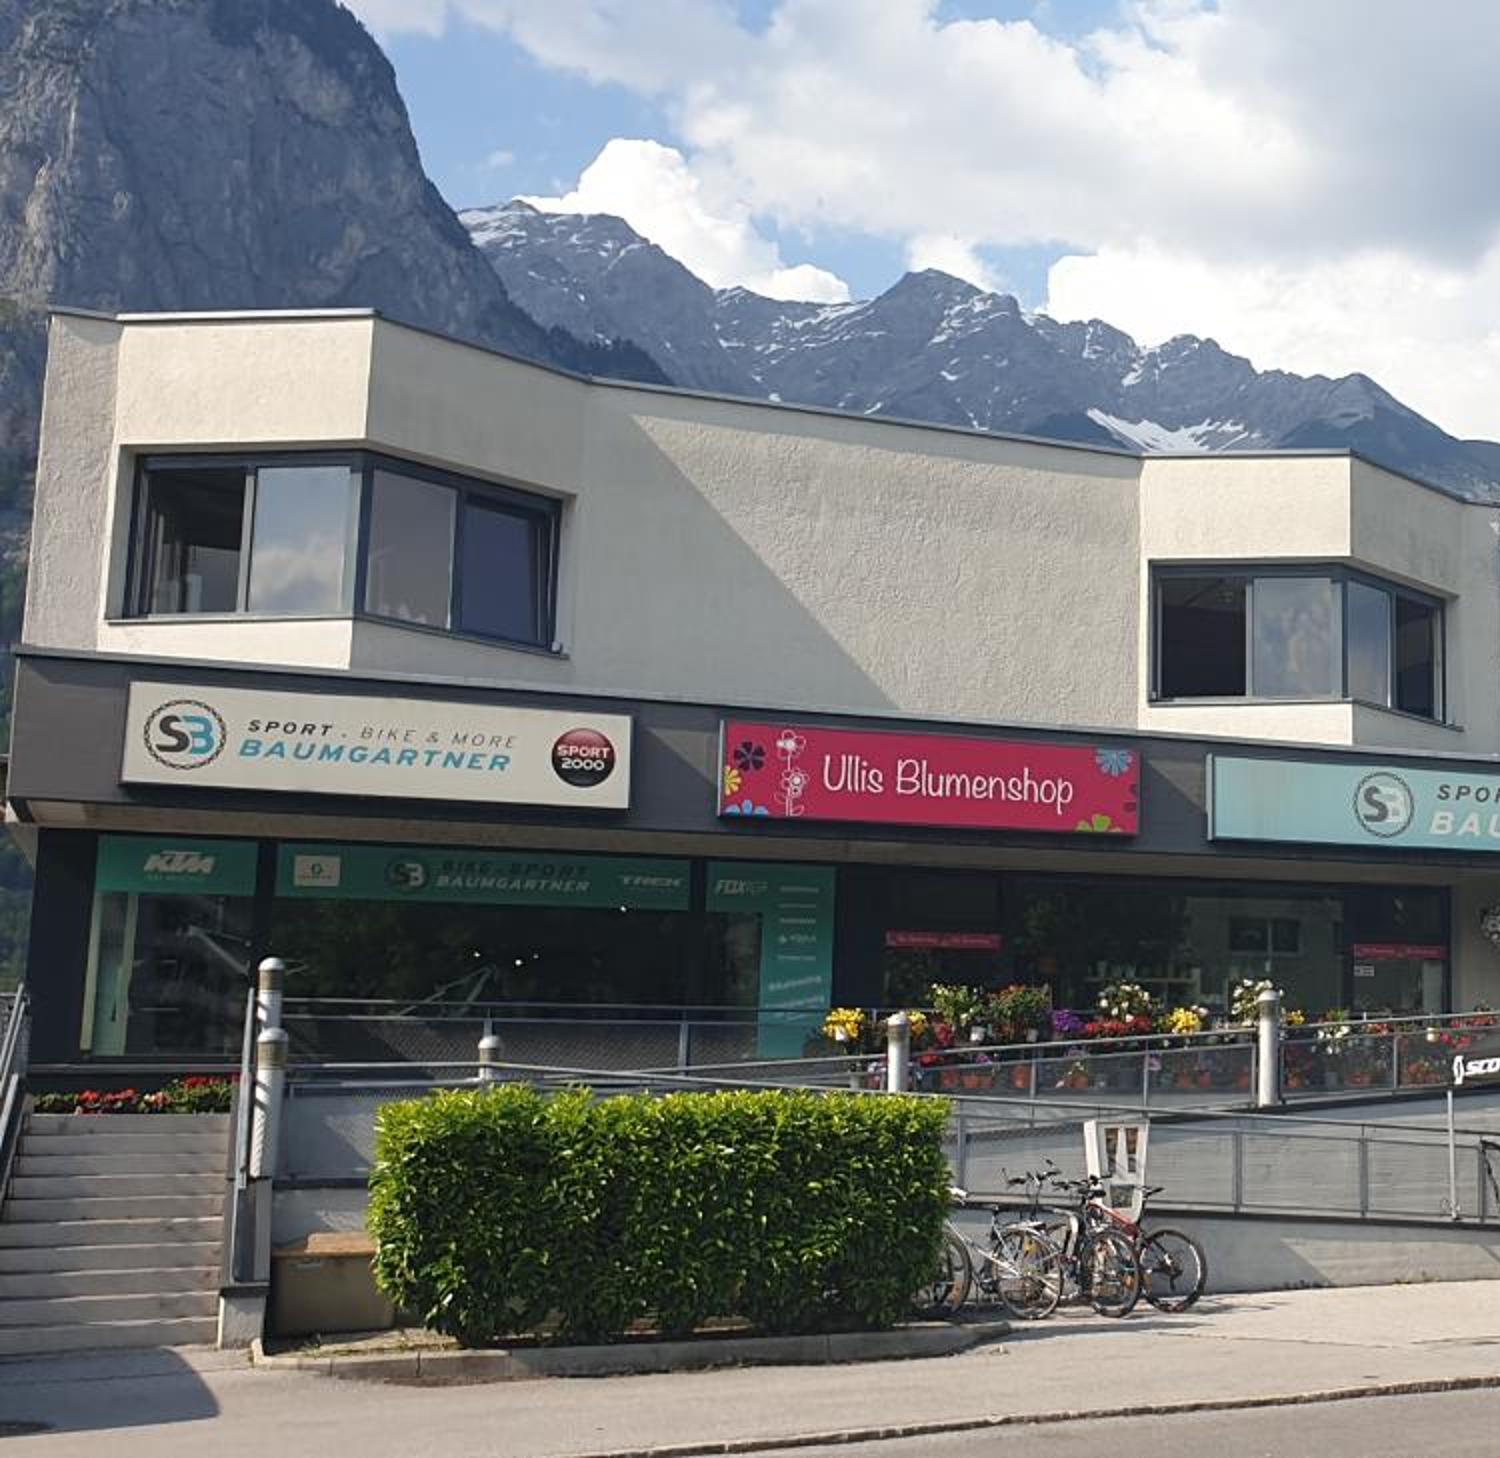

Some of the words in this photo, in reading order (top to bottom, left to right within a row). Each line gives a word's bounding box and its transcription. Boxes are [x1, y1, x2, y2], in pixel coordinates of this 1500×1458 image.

[247, 719, 333, 737] SPORT
[359, 727, 417, 742] BIKE
[425, 731, 439, 743] &
[451, 733, 520, 749] MORE
[238, 739, 512, 771] BAUMGARTNER
[556, 745, 611, 759] SPORT
[560, 757, 606, 771] 2000
[822, 754, 884, 793] Ullis
[896, 759, 1074, 815] Blumenshop
[143, 850, 216, 874] KTM
[434, 875, 592, 893] BAUMGARTNER
